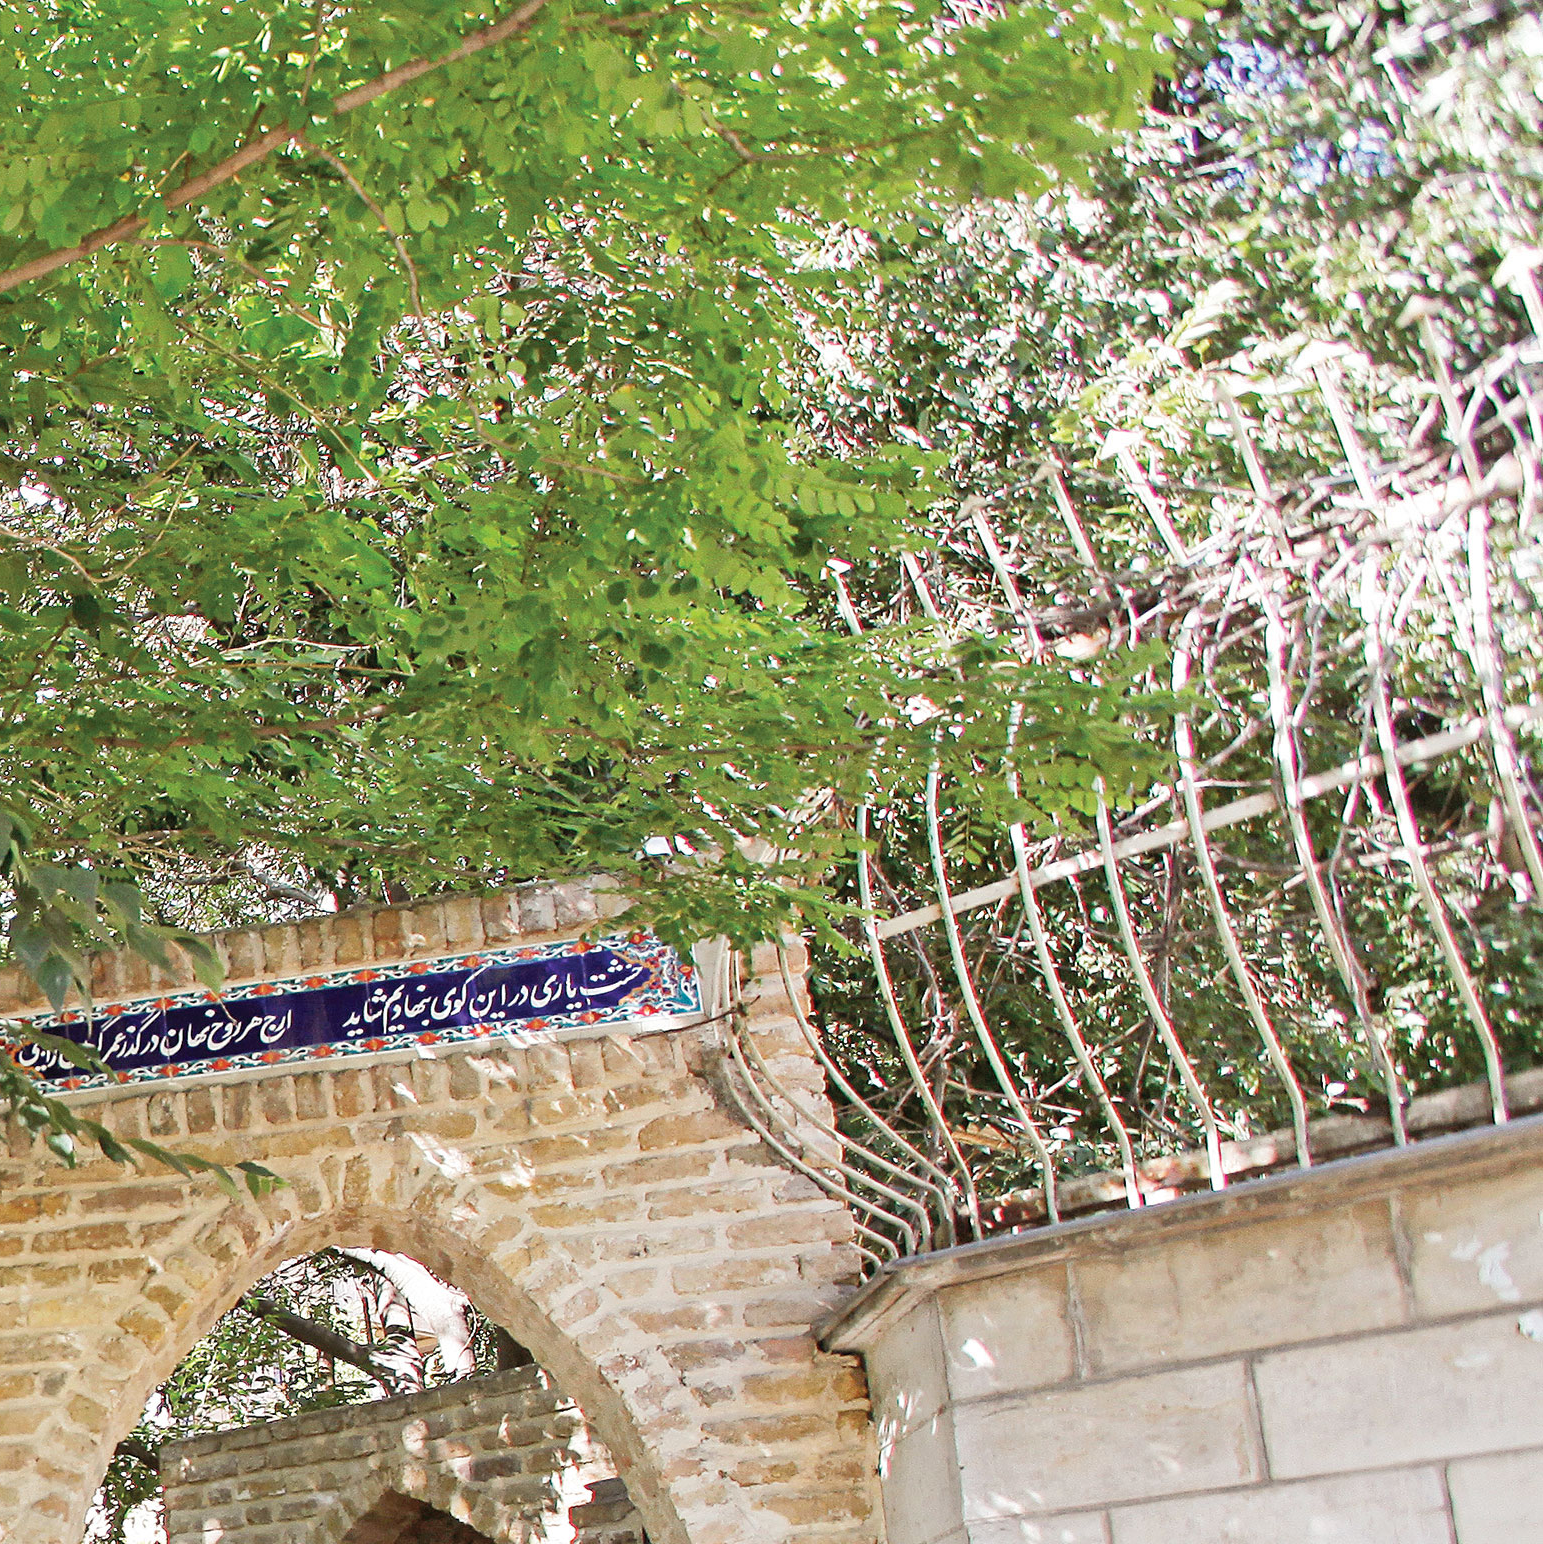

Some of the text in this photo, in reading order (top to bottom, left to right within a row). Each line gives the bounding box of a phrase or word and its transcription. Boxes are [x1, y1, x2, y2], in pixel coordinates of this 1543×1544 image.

[508, 984, 529, 1007] در
[531, 973, 583, 1010] یاری
[579, 959, 644, 997] خشت
[342, 987, 388, 1037] شاید
[468, 983, 506, 1020] این
[139, 1034, 160, 1055] در
[234, 1015, 263, 1043] هر
[260, 1009, 292, 1044] ارج
